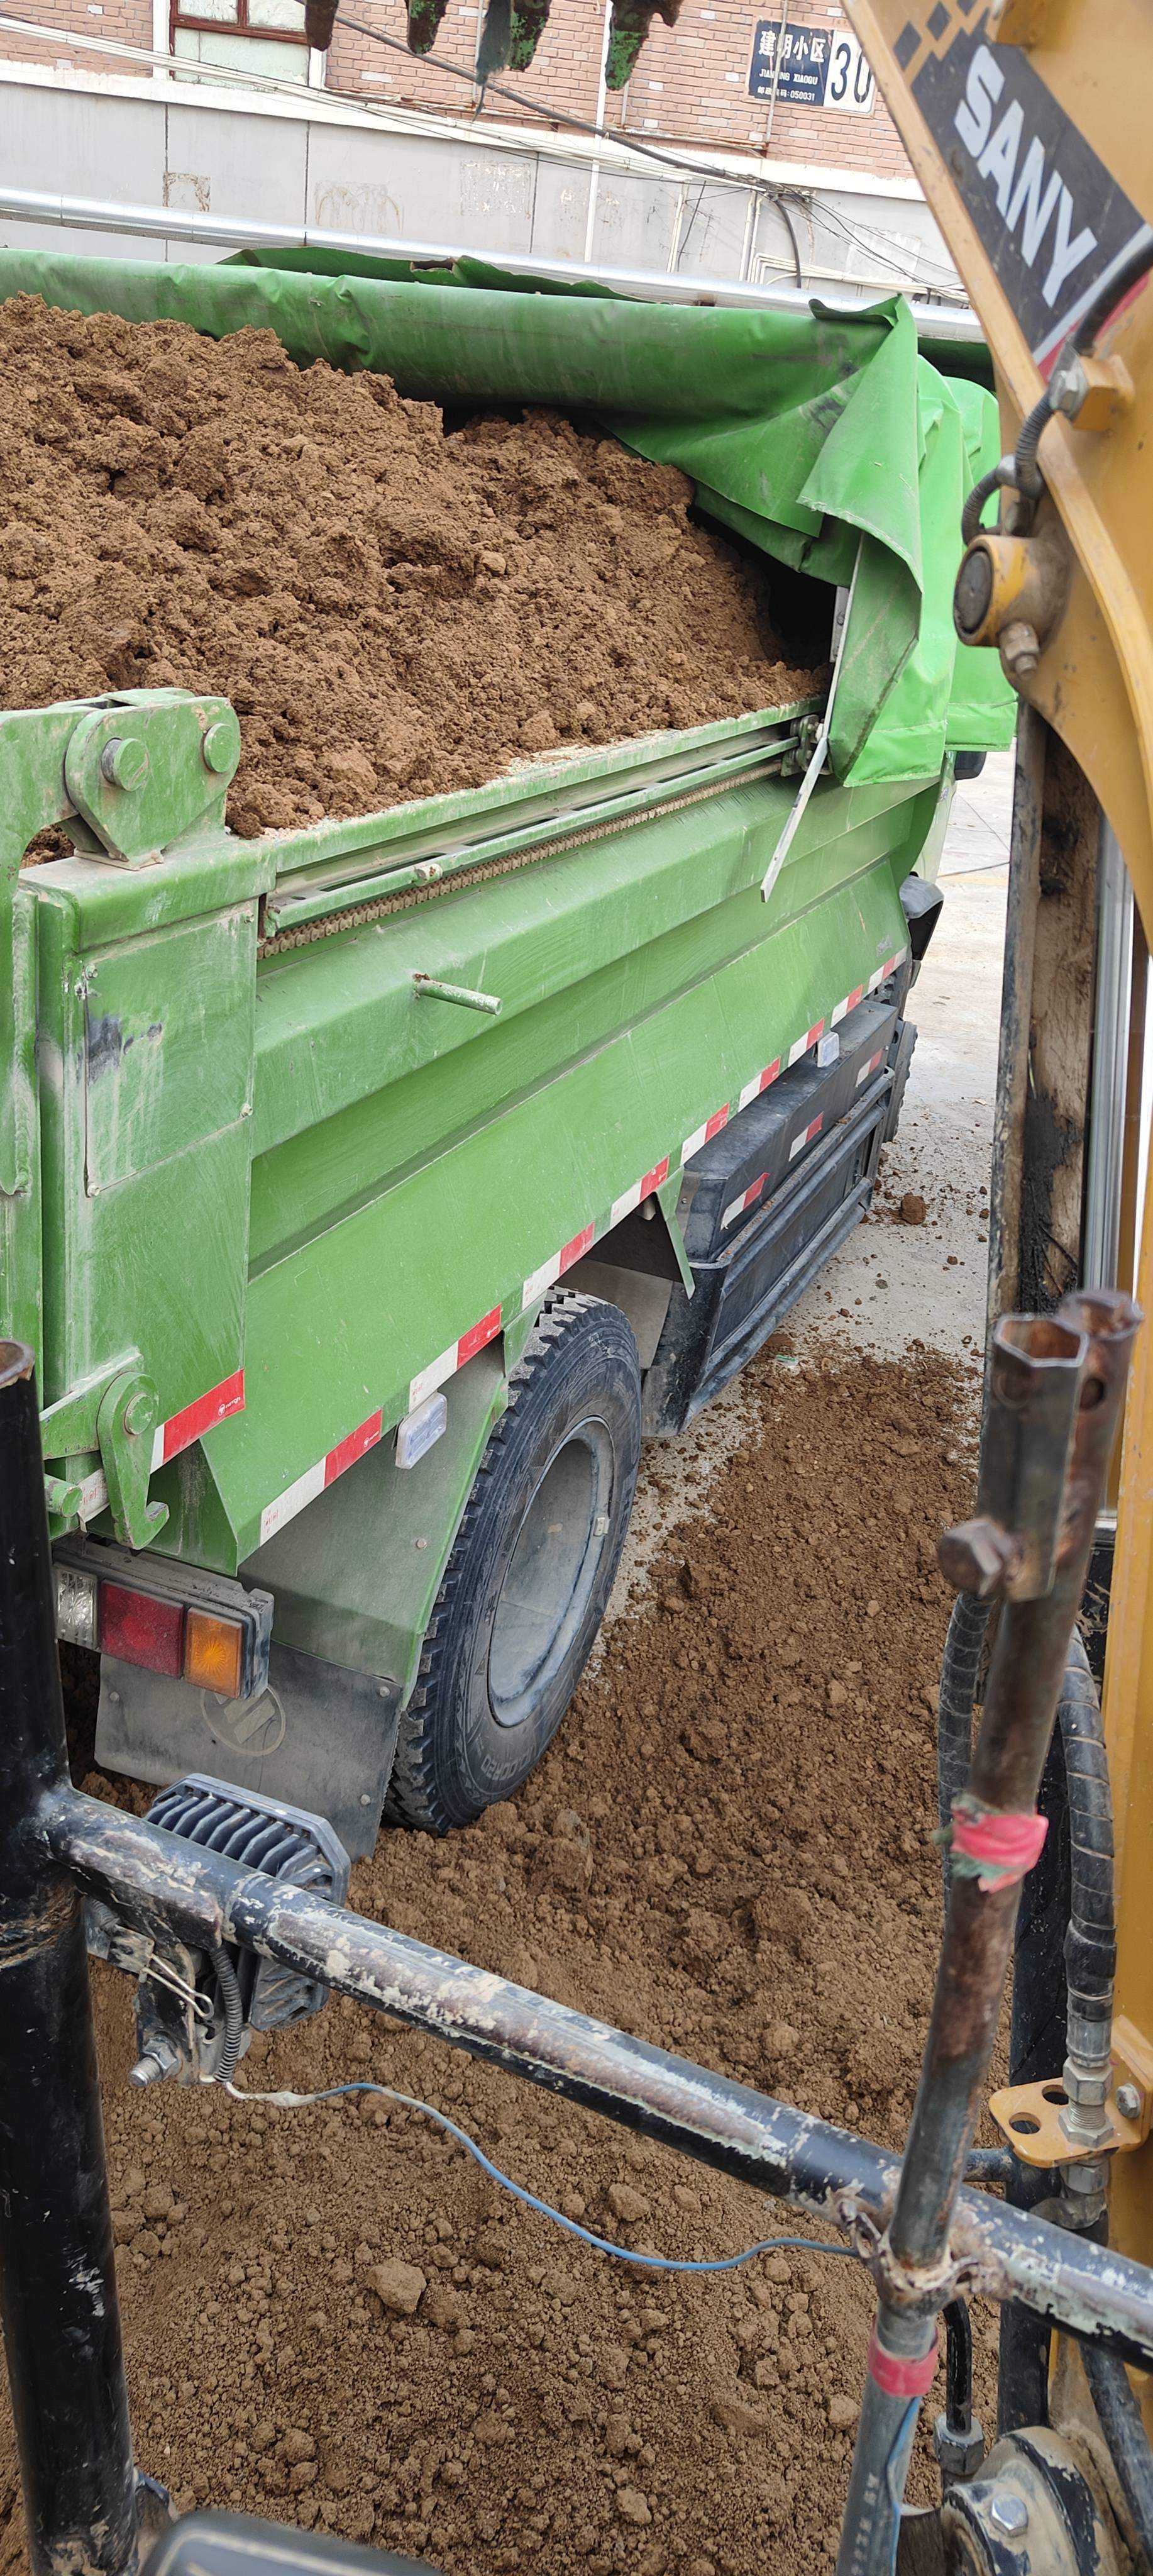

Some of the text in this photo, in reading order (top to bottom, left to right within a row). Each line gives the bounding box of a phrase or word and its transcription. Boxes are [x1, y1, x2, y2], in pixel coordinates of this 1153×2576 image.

[759, 69, 818, 85] JIANING XIAOQU
[831, 43, 873, 103] 30
[954, 43, 1098, 308] SANY
